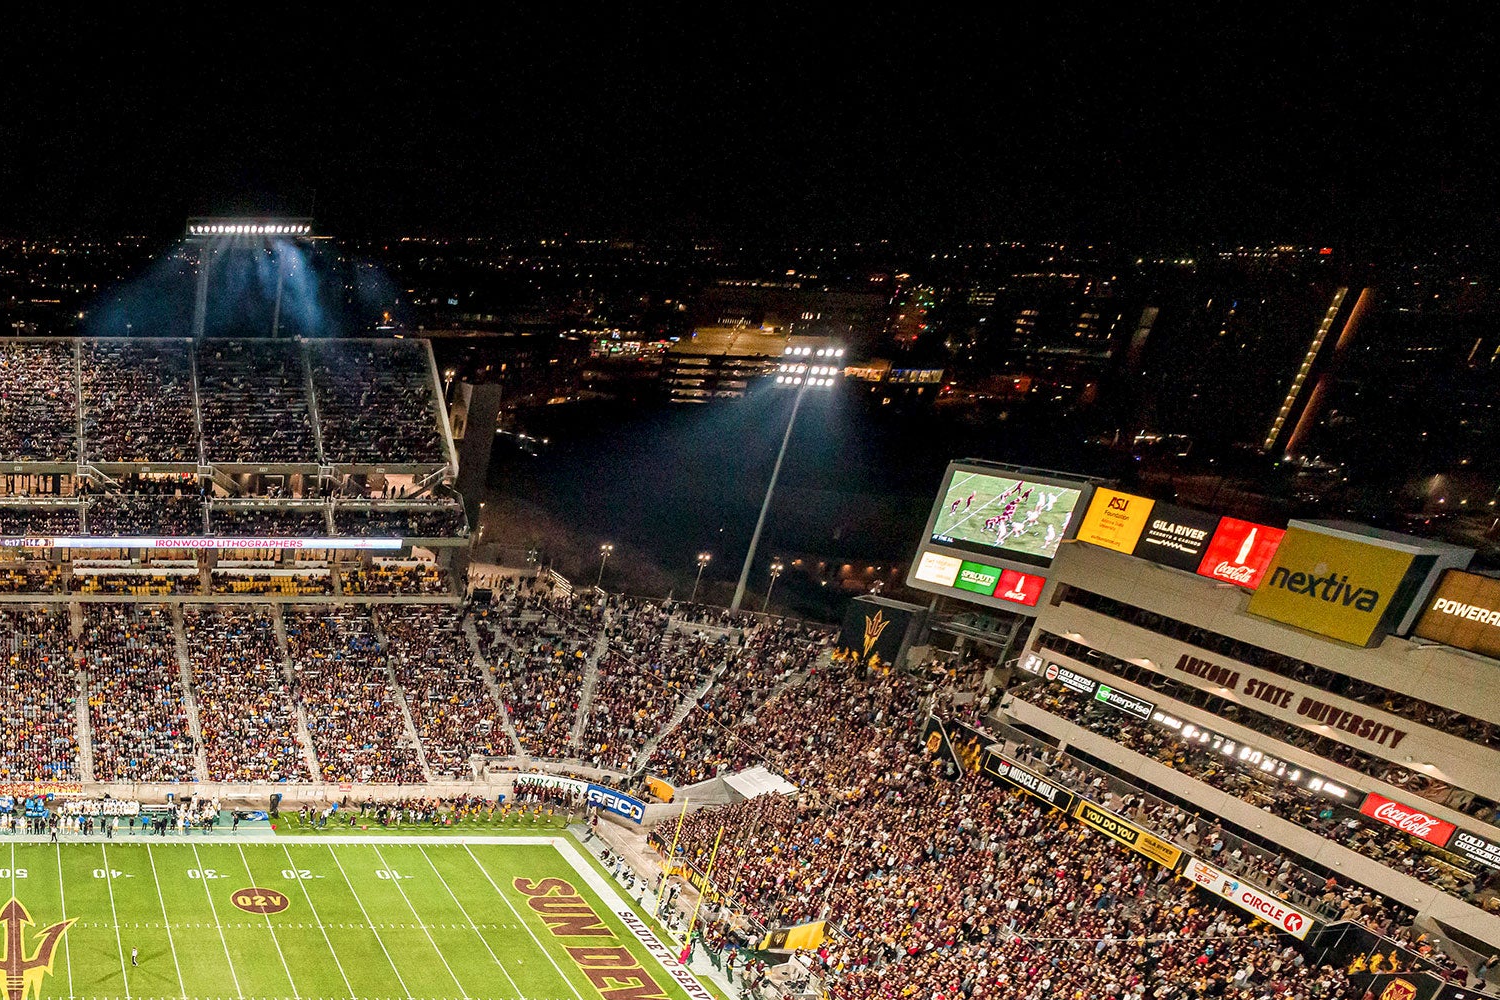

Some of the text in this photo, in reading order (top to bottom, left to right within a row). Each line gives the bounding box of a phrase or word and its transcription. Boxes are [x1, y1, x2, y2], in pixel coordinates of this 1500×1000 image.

[1104, 508, 1130, 520] Foundation
[1107, 496, 1130, 512] ASU
[155, 539, 303, 548] IRONWOOD LITHOGRAPHERS
[1152, 520, 1205, 540] GILA RIVER
[961, 570, 996, 584] SPROUTS
[1269, 566, 1379, 612] nextiva
[1432, 598, 1500, 628] POWERA
[1100, 688, 1151, 715] enterprise
[1174, 654, 1408, 749] ARIZONA STATE UNIVERSITY
[1009, 766, 1059, 802] MUSCLE MILK
[588, 789, 642, 820] GEICO
[1086, 810, 1136, 842] YOU DO YOU
[1458, 832, 1485, 848] COLD
[512, 876, 619, 940] SUN
[1242, 892, 1302, 932] CIRCLE K
[618, 911, 664, 952] SALUTE
[656, 950, 680, 968] TO
